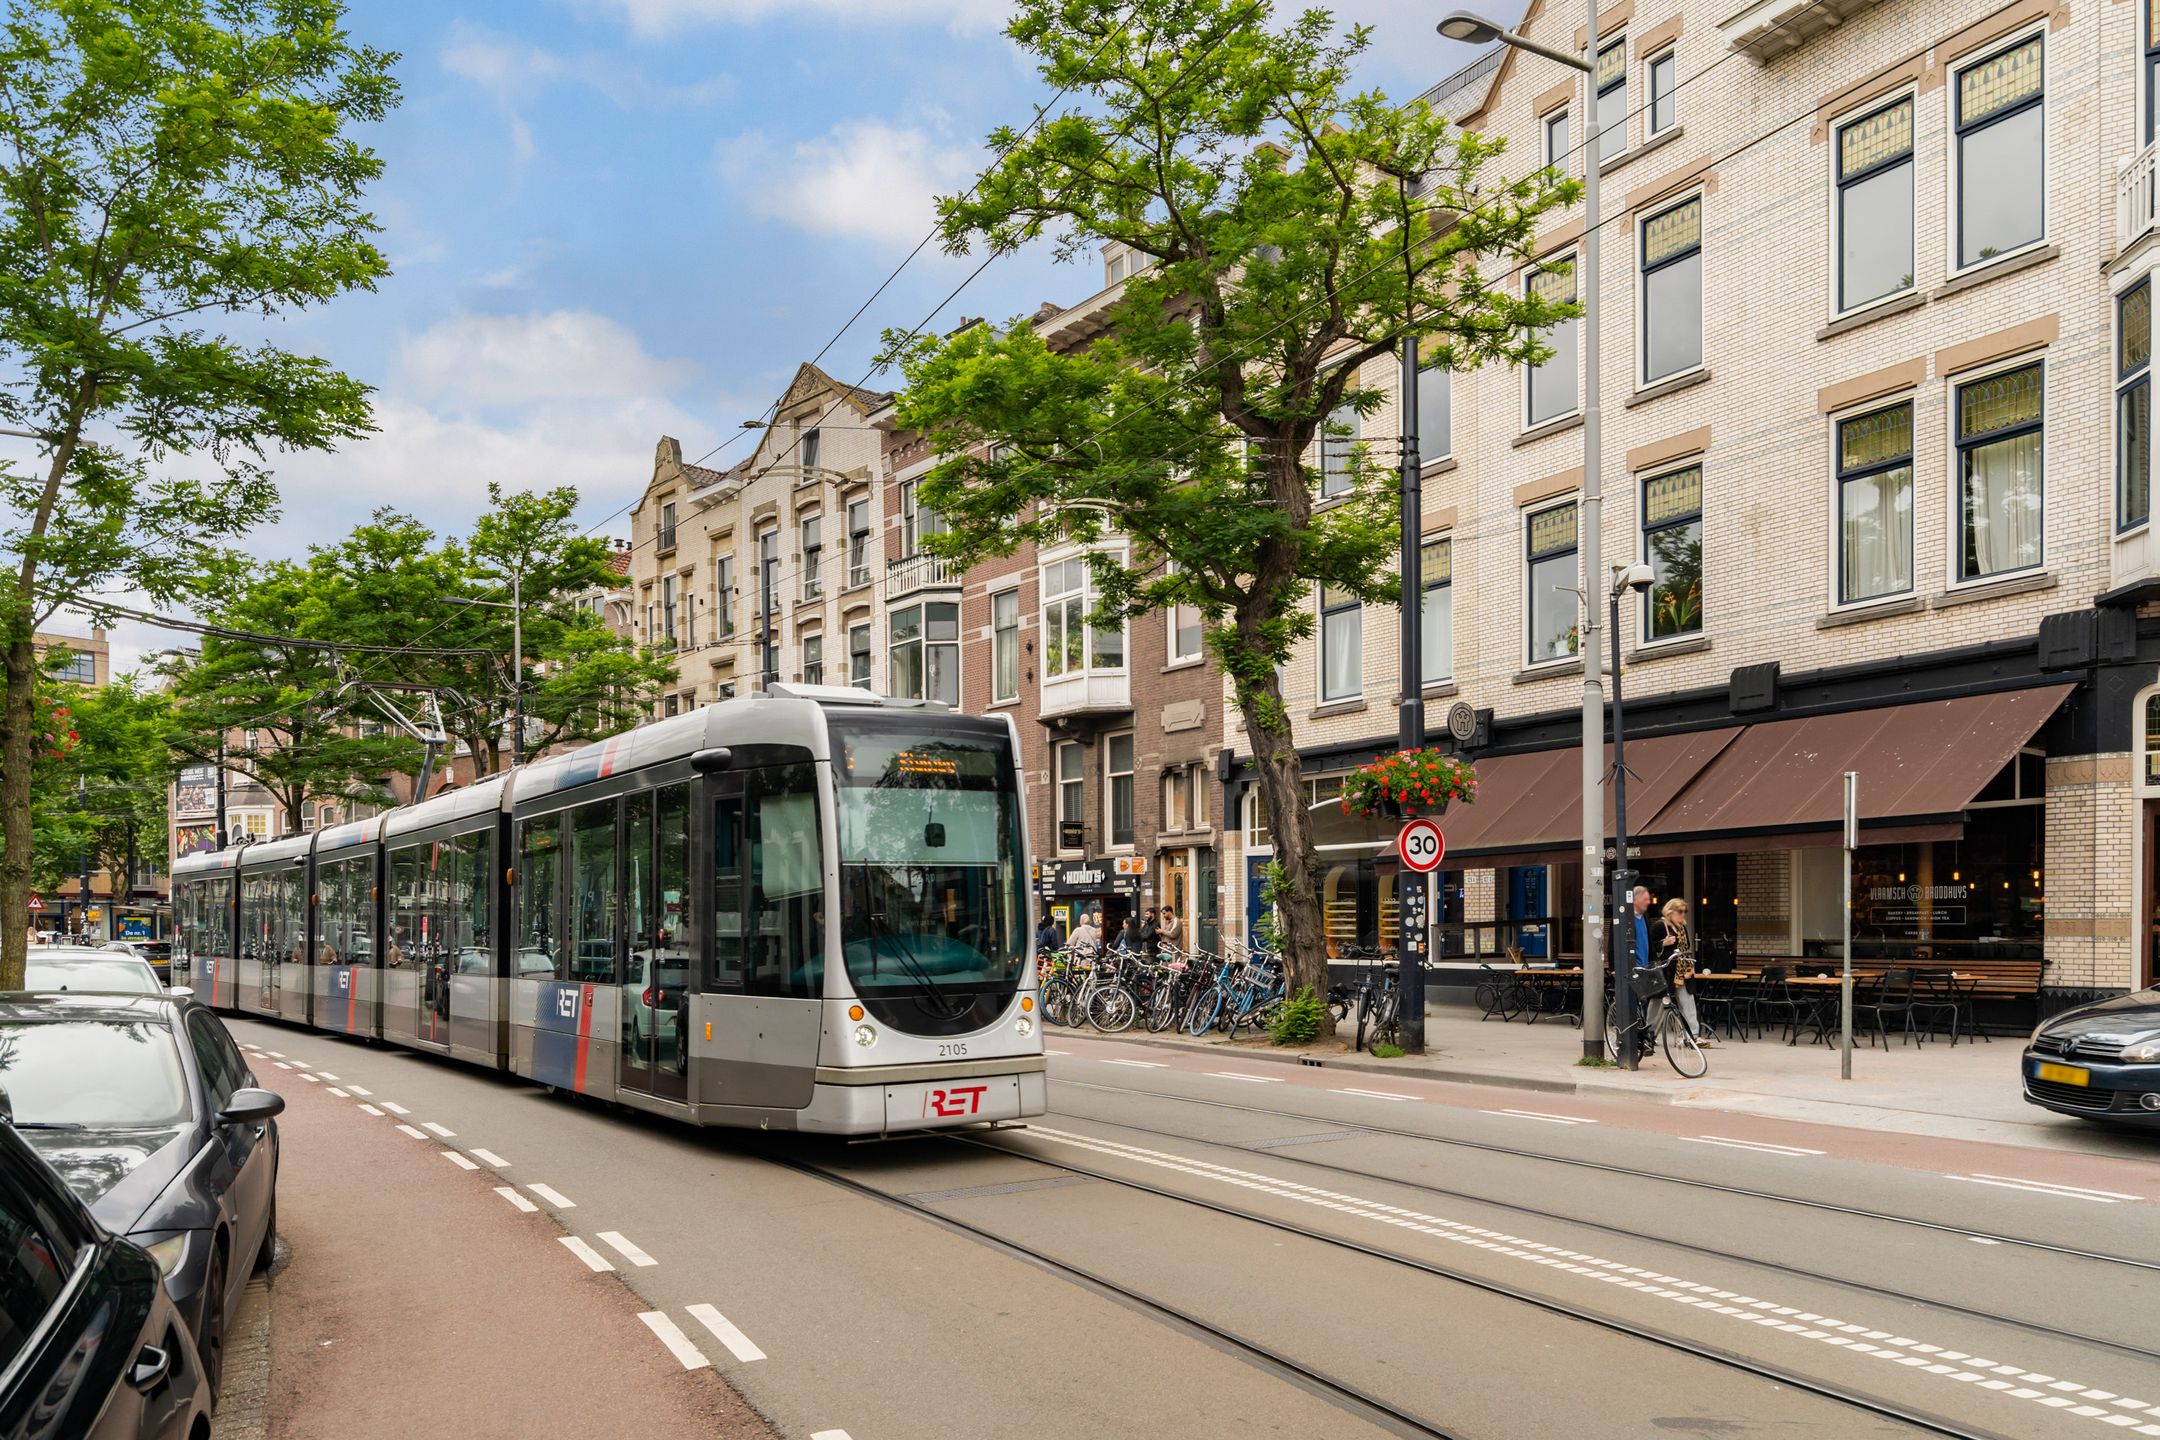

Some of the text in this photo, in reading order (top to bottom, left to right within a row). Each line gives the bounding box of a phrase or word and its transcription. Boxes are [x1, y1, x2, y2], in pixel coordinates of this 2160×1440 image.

[1409, 836, 1437, 855] 30
[1925, 886, 1967, 900] BROODHUYS
[338, 971, 350, 989] RET
[559, 988, 579, 1018] RET
[939, 1043, 968, 1057] 2105
[930, 1085, 988, 1117] RET
